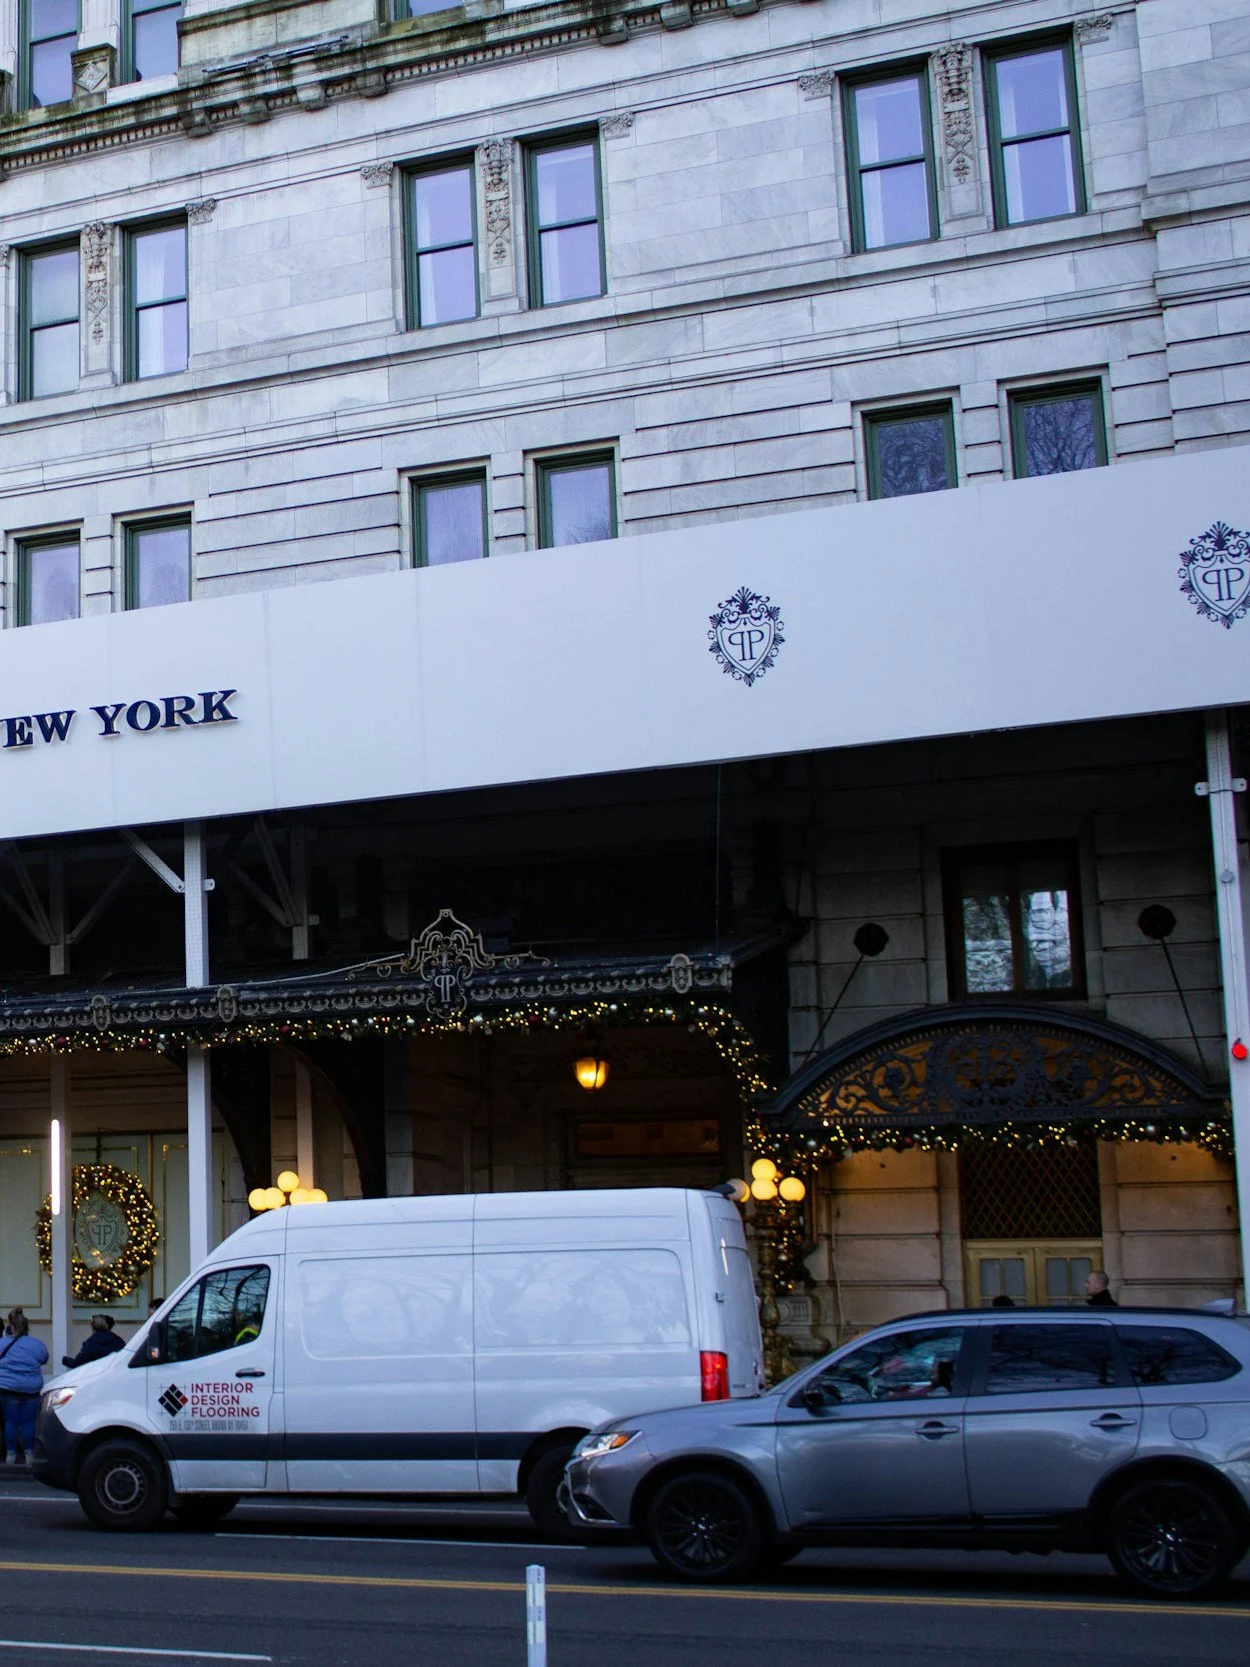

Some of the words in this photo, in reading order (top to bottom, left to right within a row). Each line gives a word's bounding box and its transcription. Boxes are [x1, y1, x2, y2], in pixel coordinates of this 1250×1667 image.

[89, 689, 239, 736] YORK
[191, 1382, 253, 1394] INTERIOR
[191, 1395, 240, 1406] DESIGN
[191, 1407, 260, 1418] FLOORING
